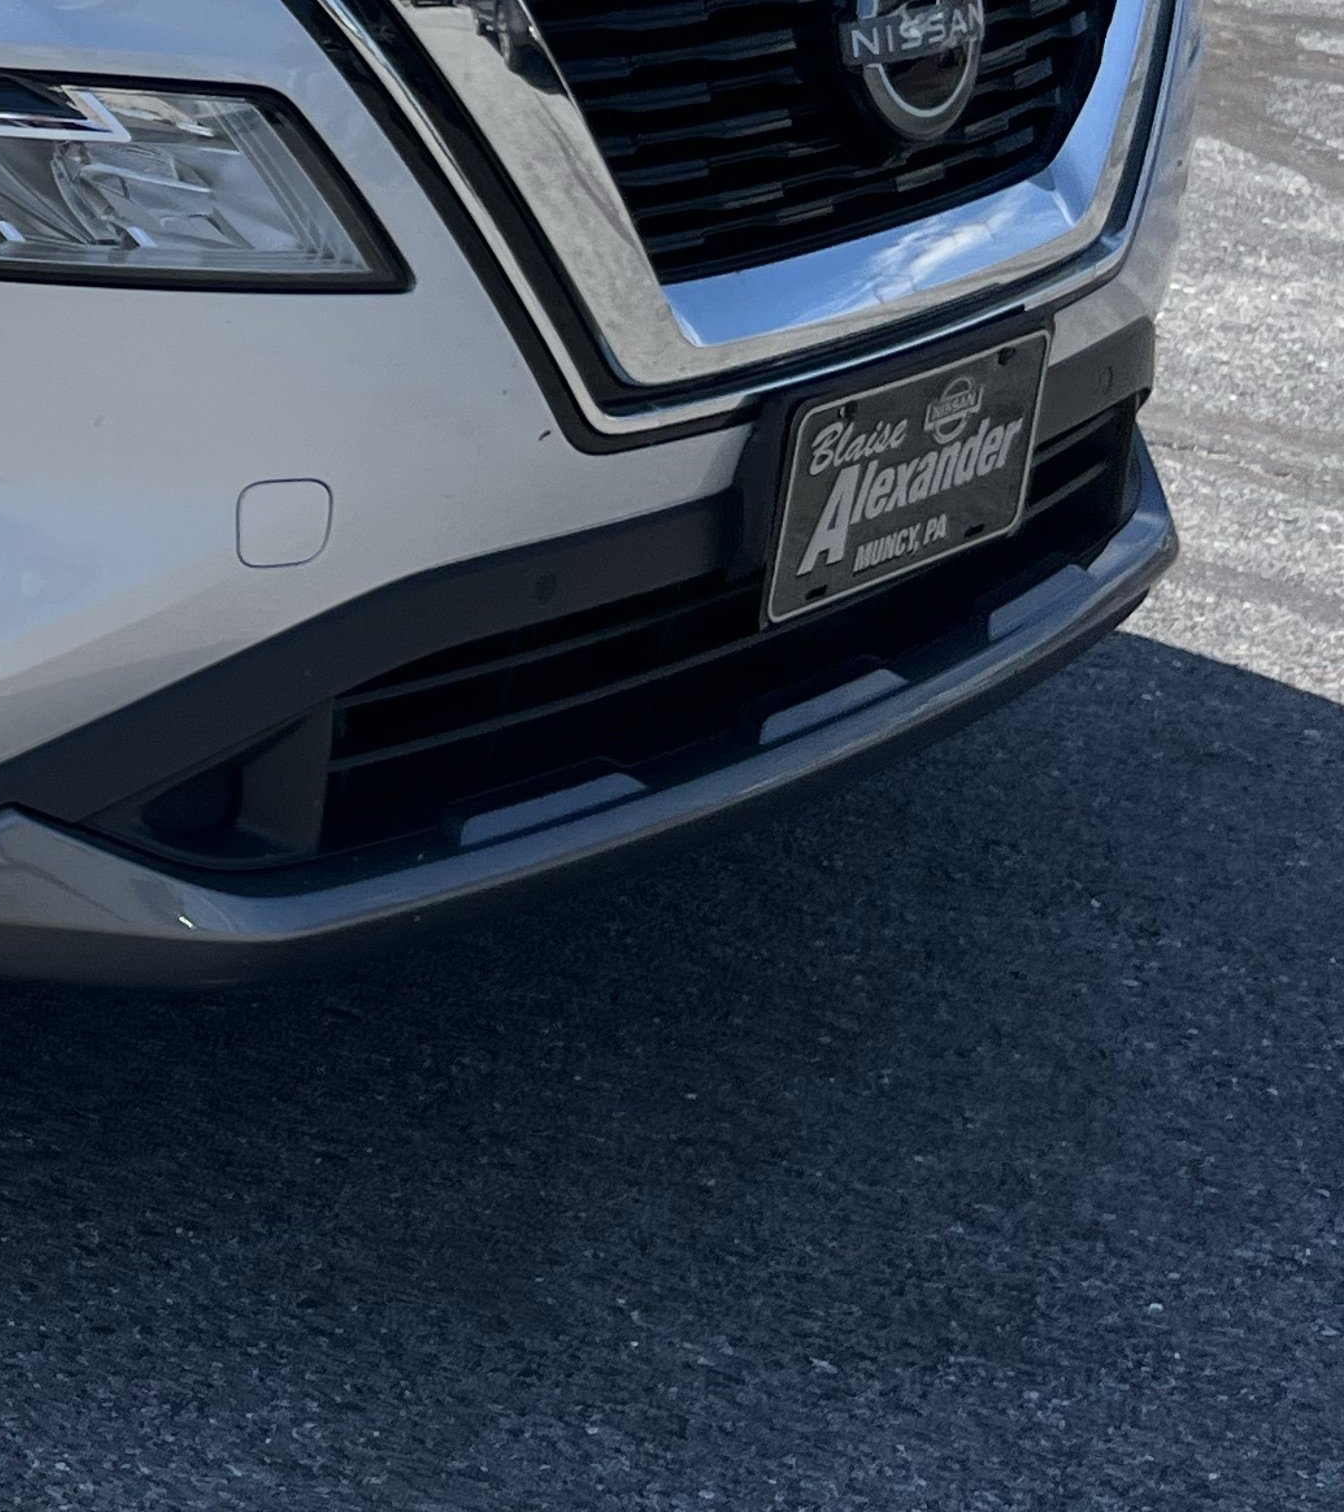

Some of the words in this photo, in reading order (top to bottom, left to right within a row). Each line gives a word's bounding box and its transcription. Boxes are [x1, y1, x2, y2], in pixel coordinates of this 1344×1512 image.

[850, 2, 985, 59] NISSAN
[809, 418, 909, 476] Blaise
[796, 417, 1024, 577] Alexander
[852, 523, 922, 575] MUNCY,
[922, 513, 948, 545] PA
